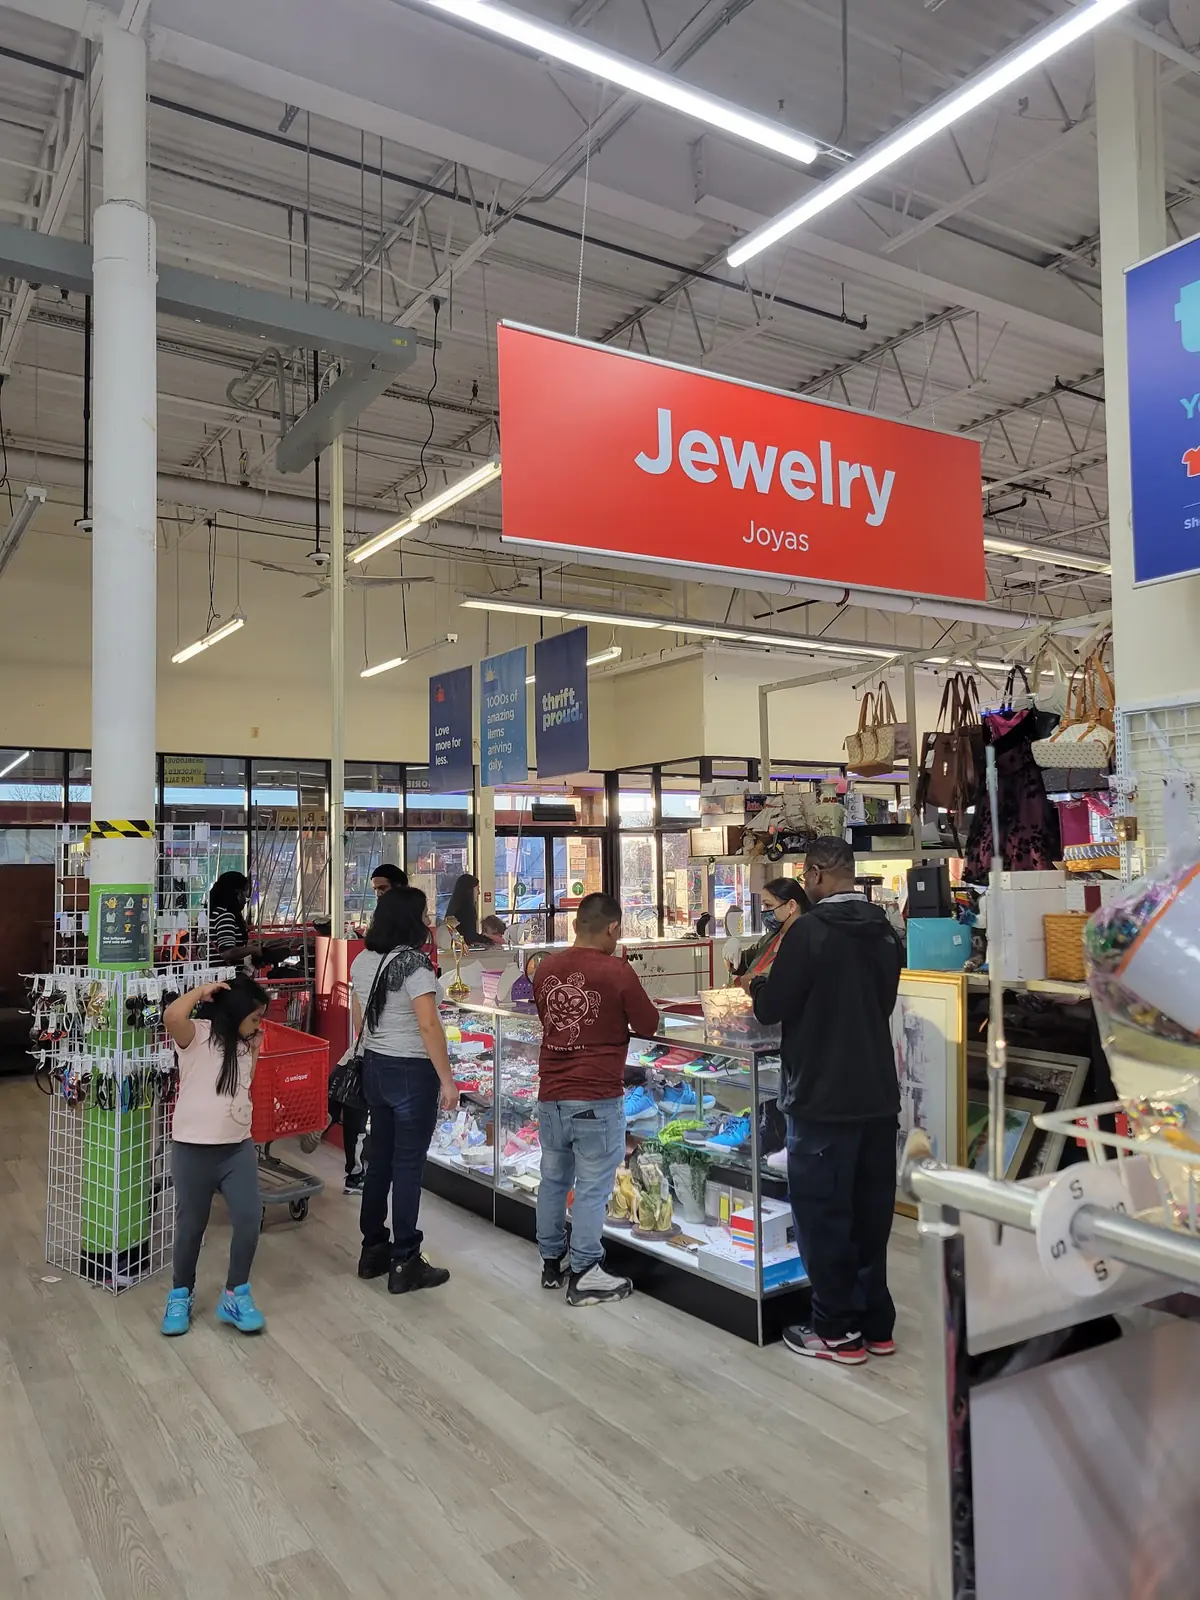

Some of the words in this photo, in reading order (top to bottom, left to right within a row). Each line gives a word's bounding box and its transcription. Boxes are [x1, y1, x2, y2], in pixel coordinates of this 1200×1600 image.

[634, 407, 896, 527] Jewelry
[742, 519, 810, 553] Joyas
[486, 693, 509, 709] 1000s
[509, 689, 519, 704] of
[542, 687, 576, 712] thrift
[487, 708, 515, 725] amazing
[542, 701, 584, 732] proud.
[434, 724, 450, 737] Love
[487, 726, 505, 740] items
[435, 739, 451, 751] more
[451, 737, 462, 748] for
[487, 741, 512, 756] arriving
[435, 754, 449, 766] less.
[488, 758, 504, 771] daily.
[290, 1073, 308, 1082] unique
[1069, 1179, 1084, 1200] S
[1050, 1239, 1067, 1259] S
[1093, 1259, 1109, 1281] S
